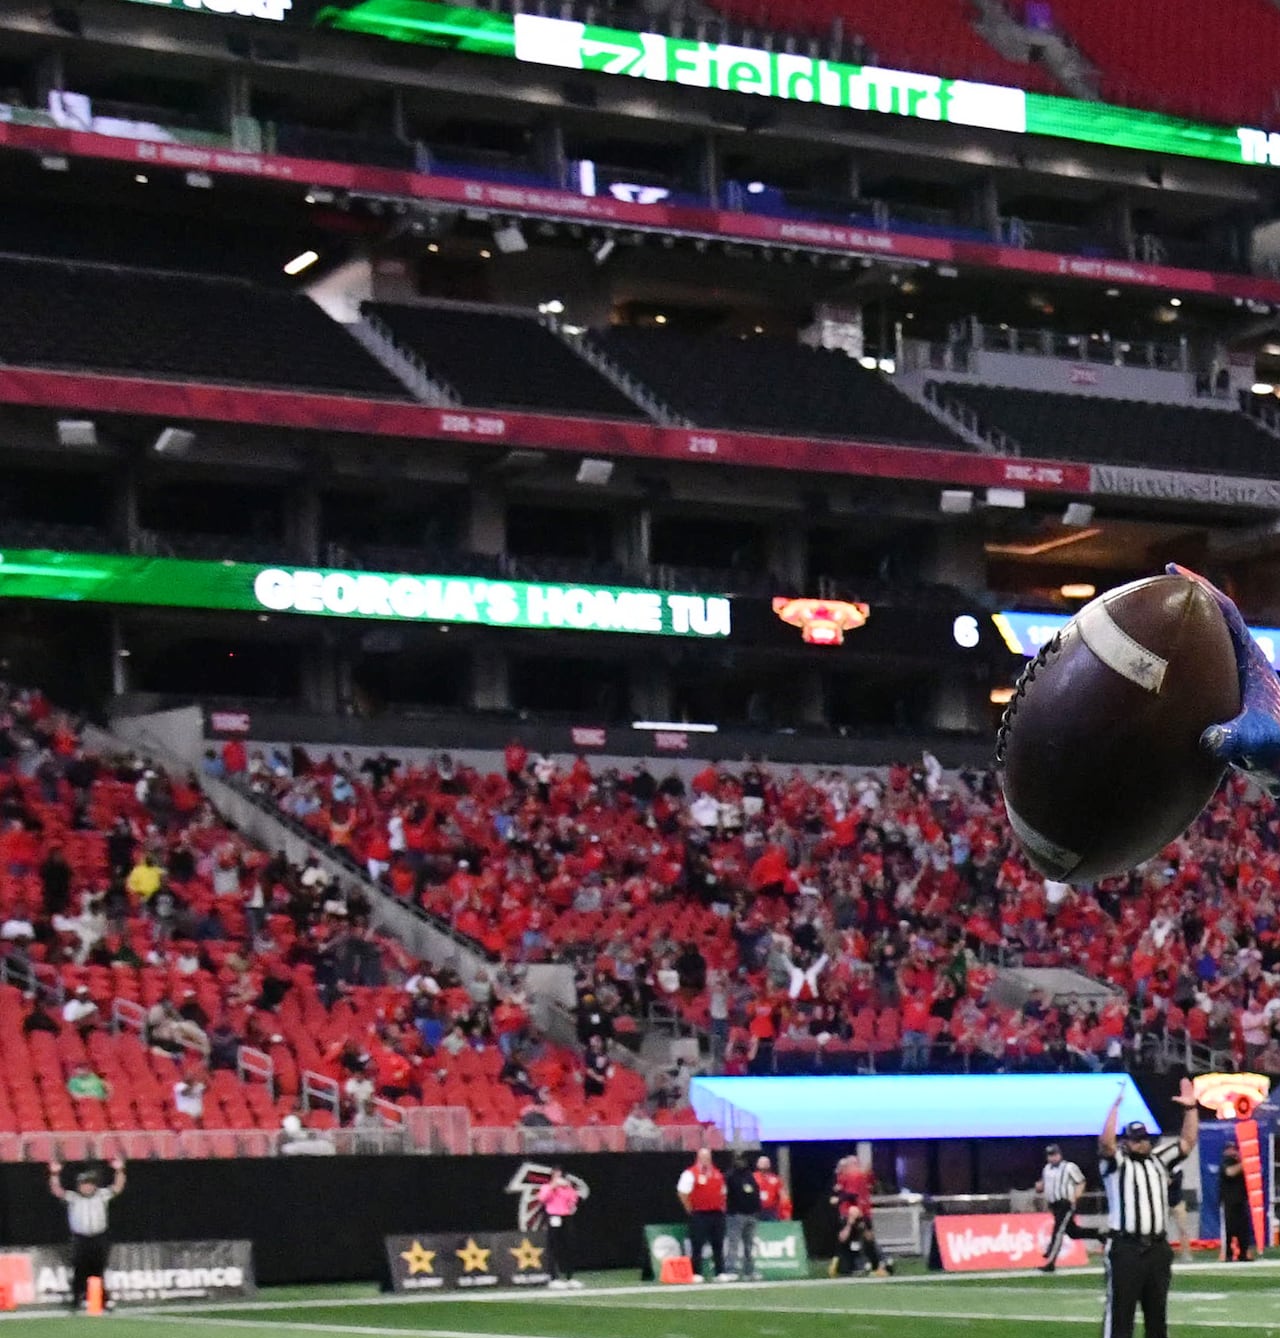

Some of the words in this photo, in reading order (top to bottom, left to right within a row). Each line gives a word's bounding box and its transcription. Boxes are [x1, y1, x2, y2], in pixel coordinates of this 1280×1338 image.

[666, 36, 956, 121] FieldTurf
[254, 568, 518, 622] GEORGIA'S
[526, 586, 662, 632] HOME
[952, 614, 980, 648] 6
[946, 1222, 1035, 1264] Wendy's
